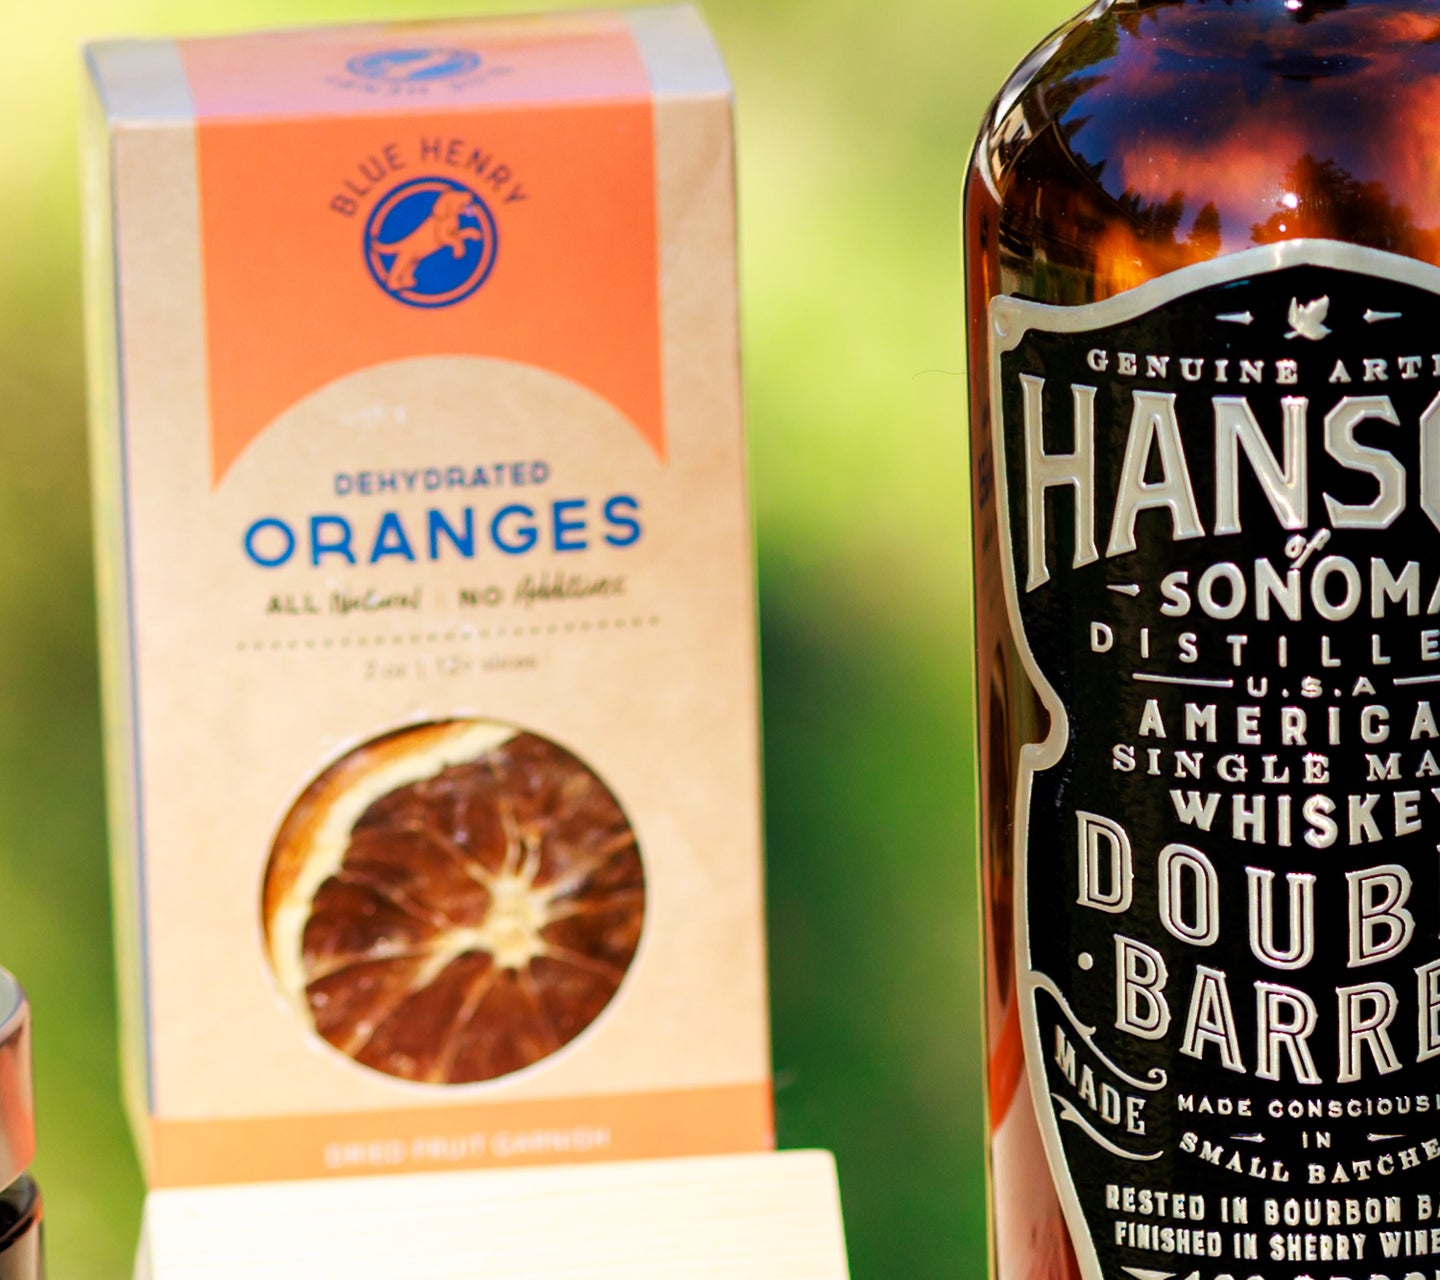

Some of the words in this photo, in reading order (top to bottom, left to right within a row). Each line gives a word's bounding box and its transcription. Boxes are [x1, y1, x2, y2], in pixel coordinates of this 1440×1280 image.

[329, 143, 407, 218] BLUE
[420, 137, 527, 204] HENRY
[1087, 348, 1300, 384] GENUINE
[334, 459, 551, 498] DEHYDRATED
[243, 493, 645, 569] ORANGES
[1284, 528, 1331, 569] of
[266, 593, 320, 615] ALL
[330, 585, 423, 616] Natural
[459, 586, 504, 608] NO
[1246, 675, 1376, 698] U.S.A
[1112, 744, 1330, 784] SINGLE
[1055, 1024, 1146, 1136] MADE
[1177, 1093, 1252, 1117] MADE
[1178, 1131, 1290, 1182] SMALL
[1302, 1131, 1331, 1149] IN
[1105, 1181, 1205, 1221] RESTED
[1220, 1195, 1247, 1225] IN
[1264, 1195, 1402, 1226] BOURBON
[1114, 1219, 1222, 1258] FINISHED
[1233, 1232, 1258, 1260] IN
[1269, 1232, 1366, 1262] SHERRY
